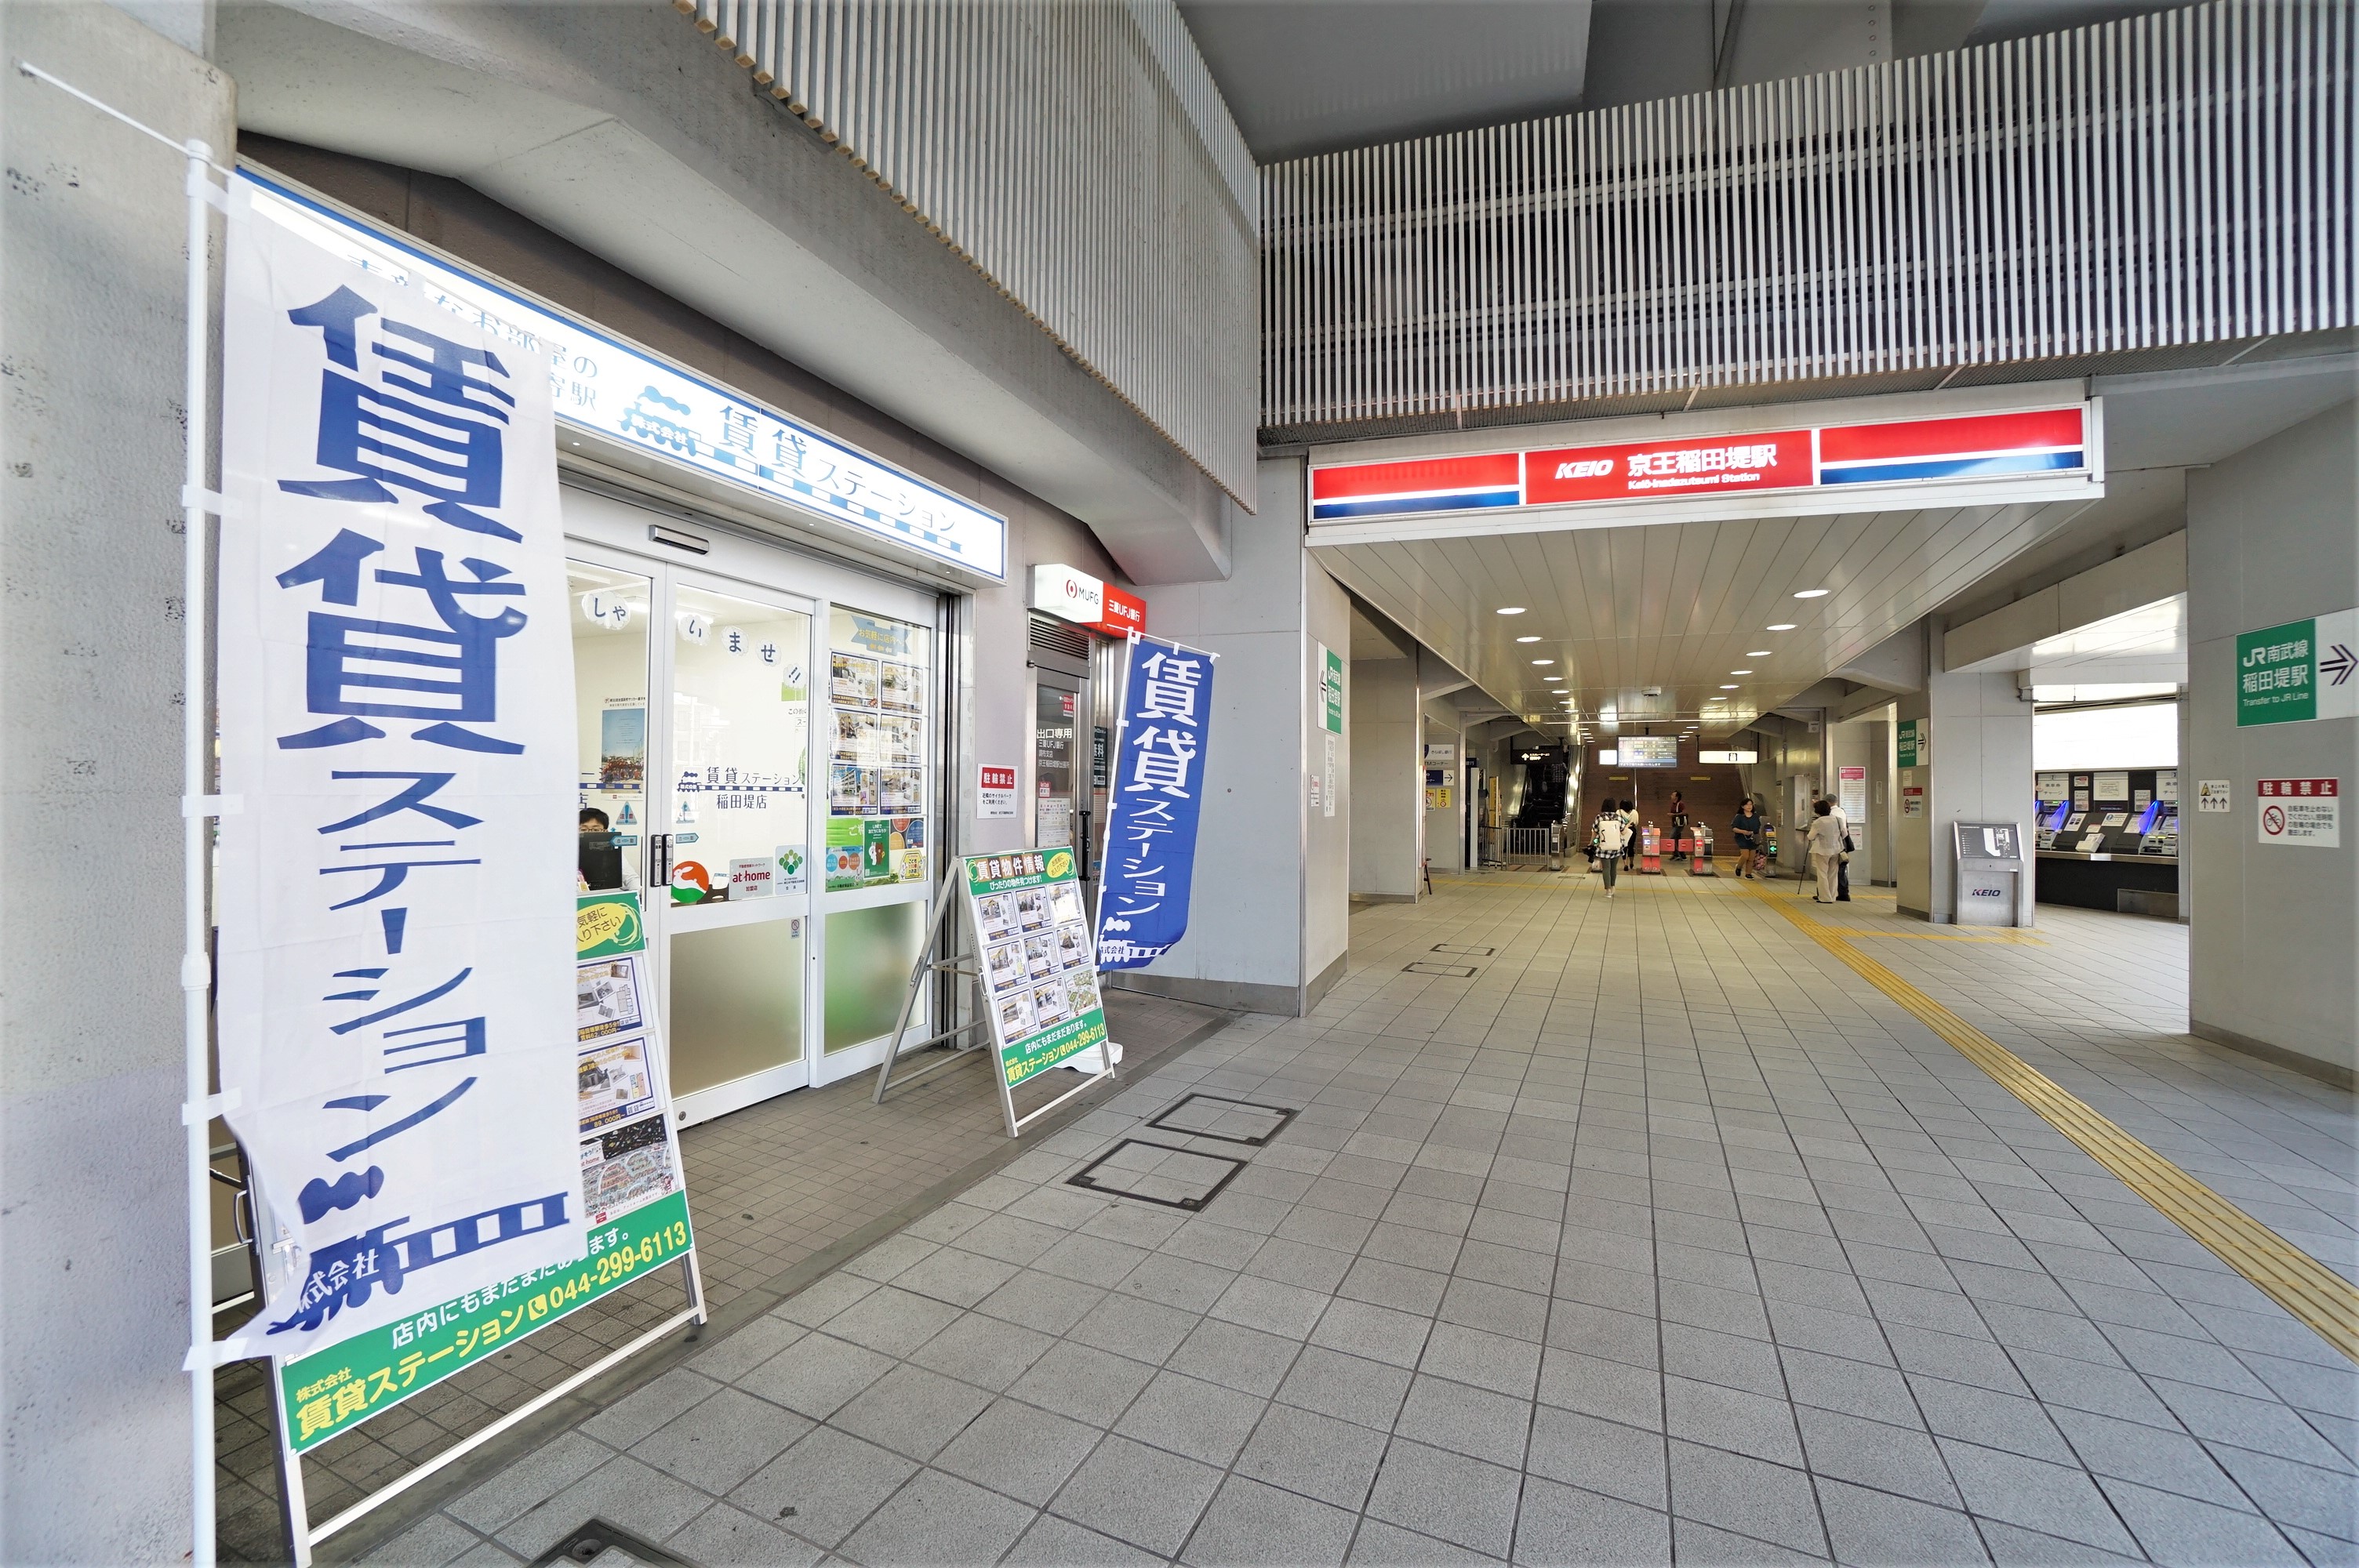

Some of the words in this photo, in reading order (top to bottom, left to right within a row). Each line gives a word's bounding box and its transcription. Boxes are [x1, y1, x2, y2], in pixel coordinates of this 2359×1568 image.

[631, 415, 689, 447] 株式会社
[719, 405, 956, 532] 賃貸ステーション
[1555, 459, 1614, 480] KEIO
[1627, 444, 1778, 477] 京王稲田堤駅
[1721, 473, 1760, 483] Station
[1078, 587, 1099, 604] MUFG
[1108, 599, 1140, 622] 三菱UFJ銀行
[2242, 639, 2309, 667] JR南武線
[2242, 664, 2309, 693] 稲田堤駅
[2243, 696, 2271, 706] Transfer
[275, 283, 529, 1162] 賃貸ステーション
[1037, 728, 1072, 739] 出口専用
[707, 766, 800, 786] 賃貸ステーション
[983, 772, 1013, 785] 駐輪禁止
[1116, 652, 1201, 916] 賃貸ステーション
[2263, 781, 2332, 795] 駐輪禁止
[717, 794, 768, 809] 稲田堤店
[732, 873, 743, 883] at
[743, 870, 770, 881] home
[976, 855, 1045, 880] 賃貸物件情報
[577, 907, 608, 928] 気軽に
[1006, 1047, 1060, 1083] 賃貸ステーション
[1066, 1022, 1105, 1053] 044-299-6113
[296, 1305, 525, 1441] 賃貸ステーション
[549, 1220, 687, 1309] 044-299-6113
[296, 1367, 353, 1403] 株式会社
